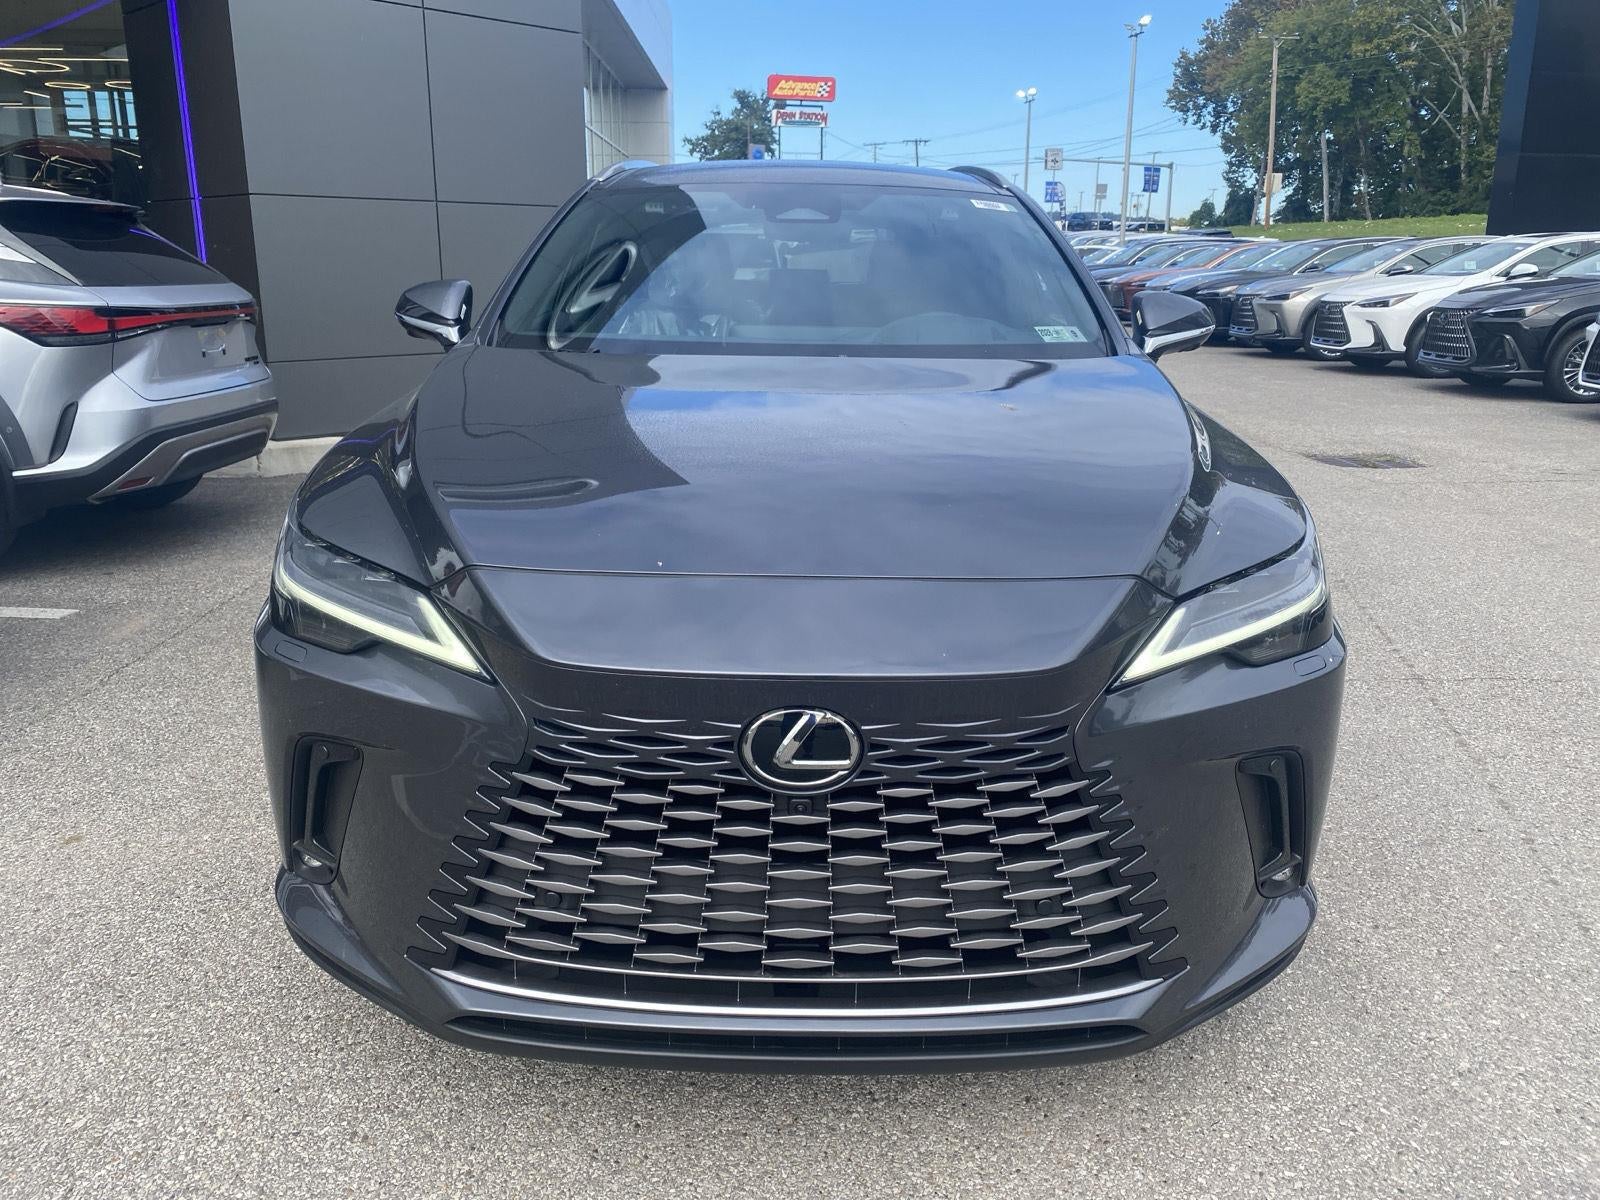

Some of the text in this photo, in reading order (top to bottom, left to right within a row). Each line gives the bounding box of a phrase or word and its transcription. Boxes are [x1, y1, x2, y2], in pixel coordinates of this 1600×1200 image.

[777, 80, 817, 90] Advance
[773, 88, 794, 96] Auto
[775, 111, 796, 125] PENN
